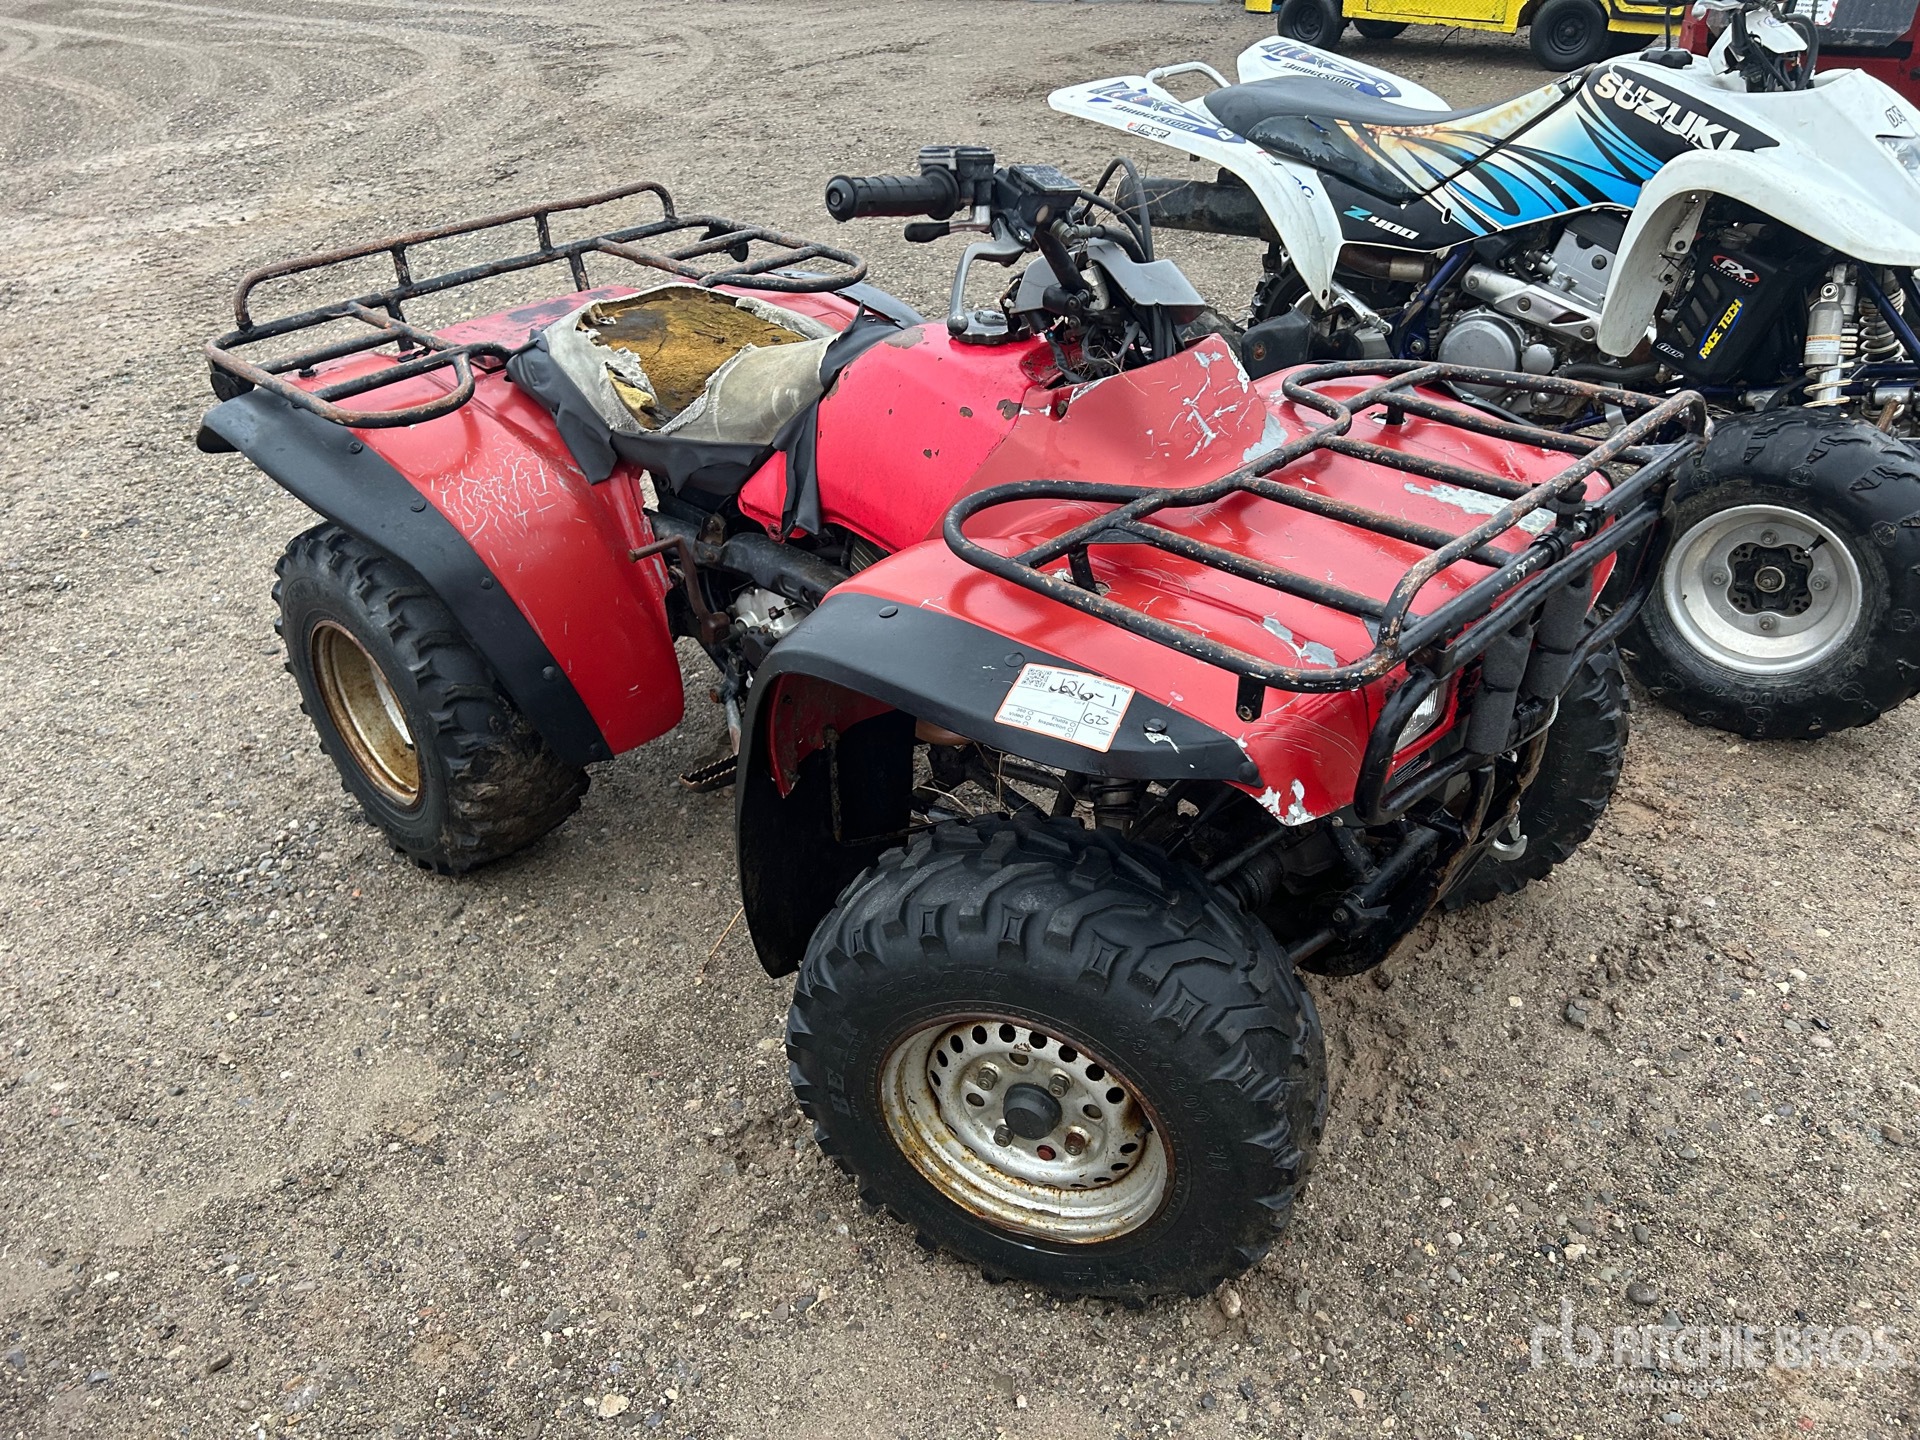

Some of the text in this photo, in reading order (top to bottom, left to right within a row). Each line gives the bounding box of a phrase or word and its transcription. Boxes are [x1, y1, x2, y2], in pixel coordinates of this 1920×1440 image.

[1594, 72, 1740, 150] SUZUKI
[1699, 298, 1743, 359] RACE TECH
